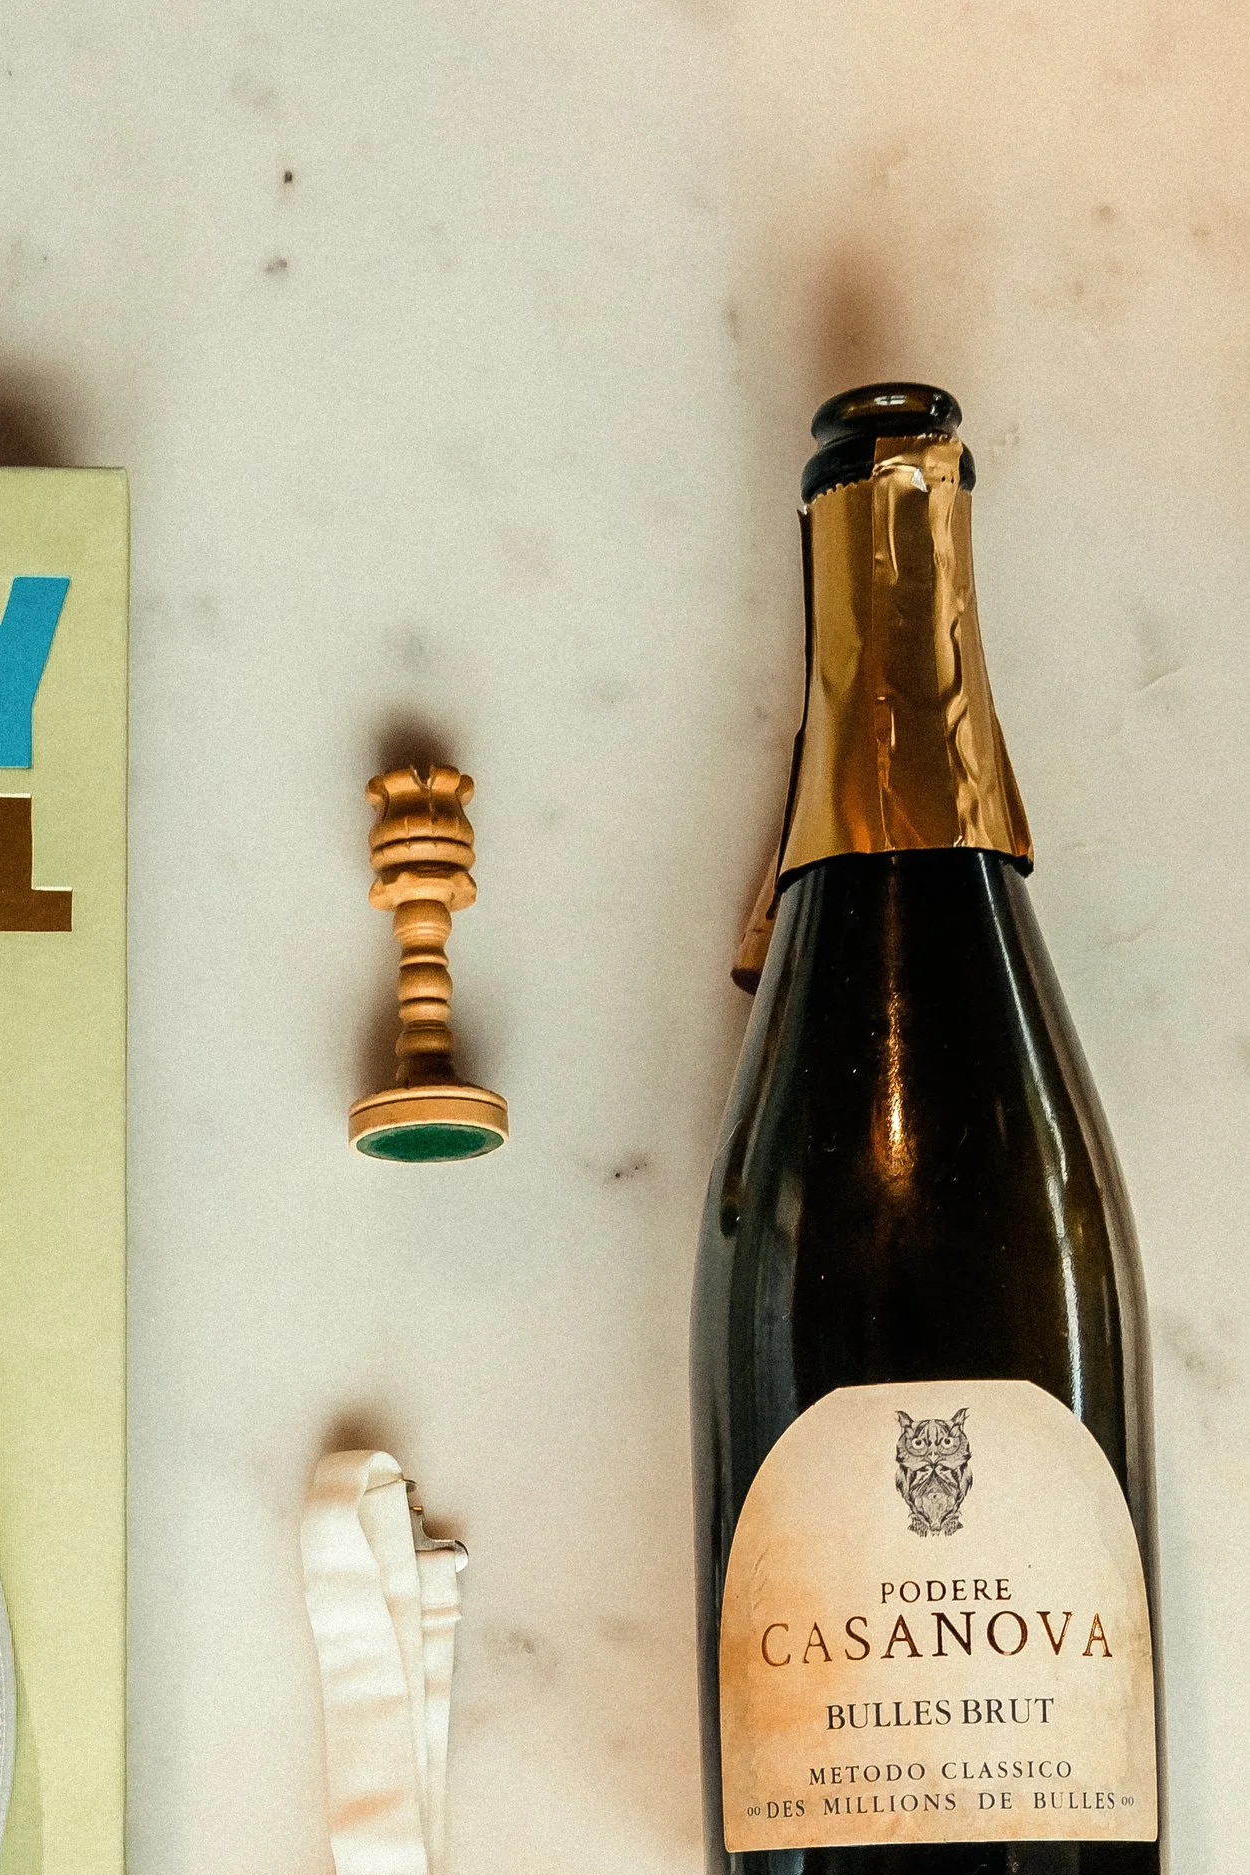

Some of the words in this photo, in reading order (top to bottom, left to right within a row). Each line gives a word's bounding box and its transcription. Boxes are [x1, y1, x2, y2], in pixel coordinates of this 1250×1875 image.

[880, 1578, 1013, 1604] PODERE
[760, 1610, 1114, 1668] CASANOVA
[825, 1699, 952, 1731] BULLES
[959, 1697, 1055, 1725] BRUT
[808, 1762, 927, 1786] METODO
[941, 1760, 1073, 1780] CLASSICO
[766, 1799, 806, 1819] DES
[822, 1792, 958, 1816] MILLIONS
[977, 1791, 1014, 1810] DE
[1033, 1791, 1116, 1810] BULLES
